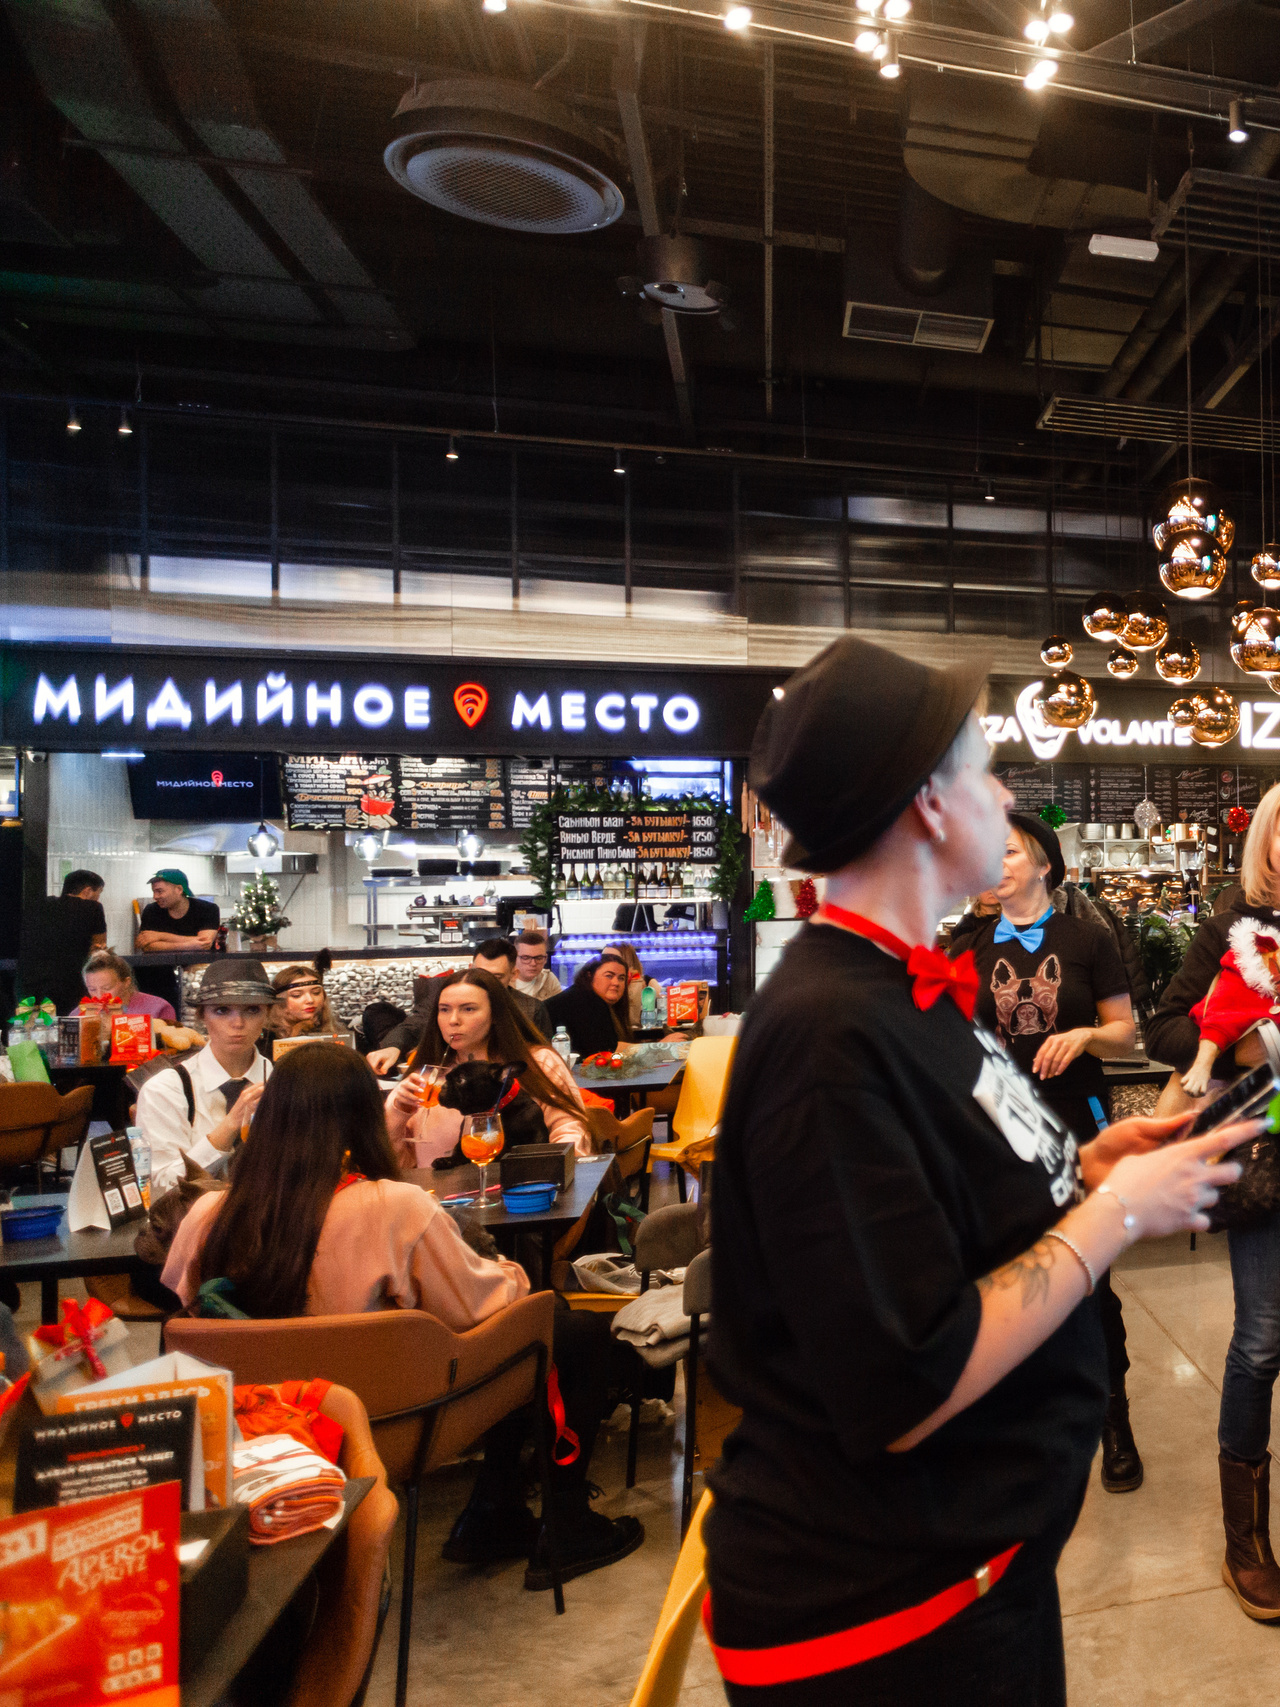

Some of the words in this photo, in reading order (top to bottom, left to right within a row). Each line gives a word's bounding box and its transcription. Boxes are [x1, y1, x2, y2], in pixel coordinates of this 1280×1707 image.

[33, 671, 431, 730] МИДИЙНОЕ
[511, 690, 700, 734] МЕСТО
[1077, 718, 1193, 746] VOLANTE
[692, 815, 713, 826] 1650
[692, 831, 713, 842] 1750
[34, 1418, 117, 1440] МИДИЙНОЕ
[137, 1409, 183, 1424] МЕСТО
[57, 1529, 166, 1590] APEROL
